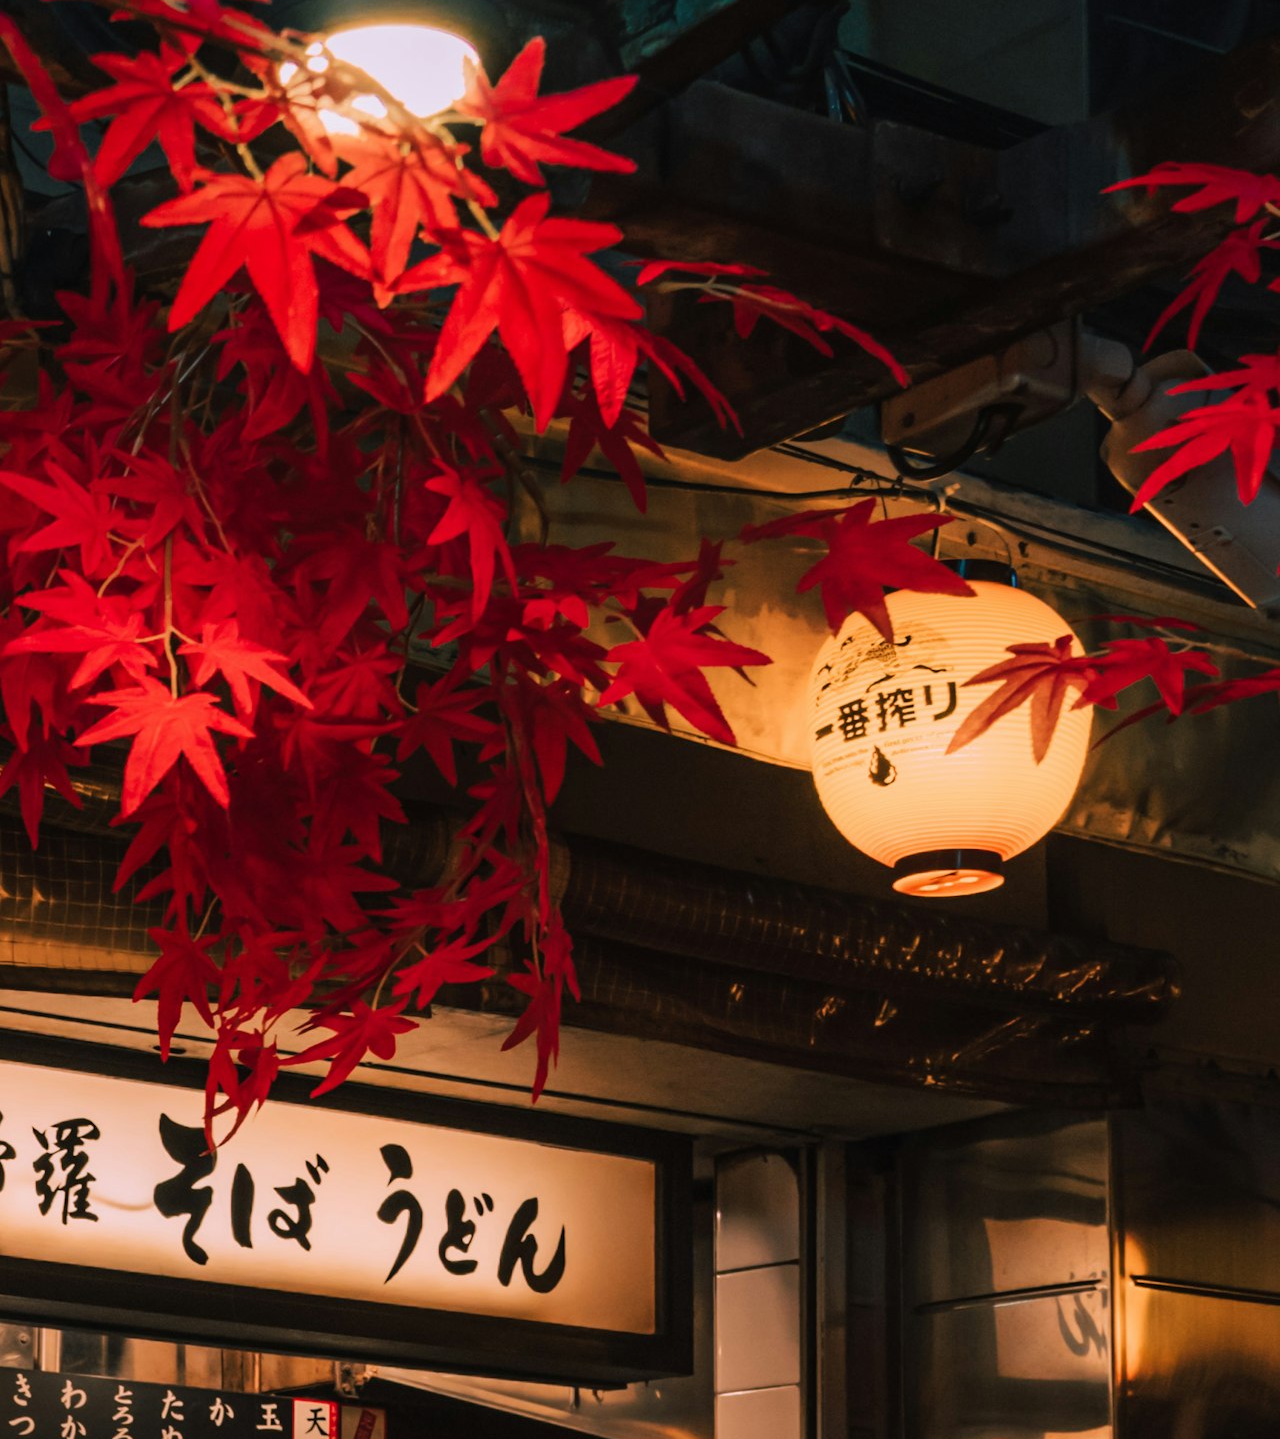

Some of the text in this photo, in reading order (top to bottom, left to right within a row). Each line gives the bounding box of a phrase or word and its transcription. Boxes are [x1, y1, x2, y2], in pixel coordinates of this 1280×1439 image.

[815, 681, 959, 744] 一番搾り
[151, 1111, 331, 1267] そば
[376, 1142, 568, 1297] うどん
